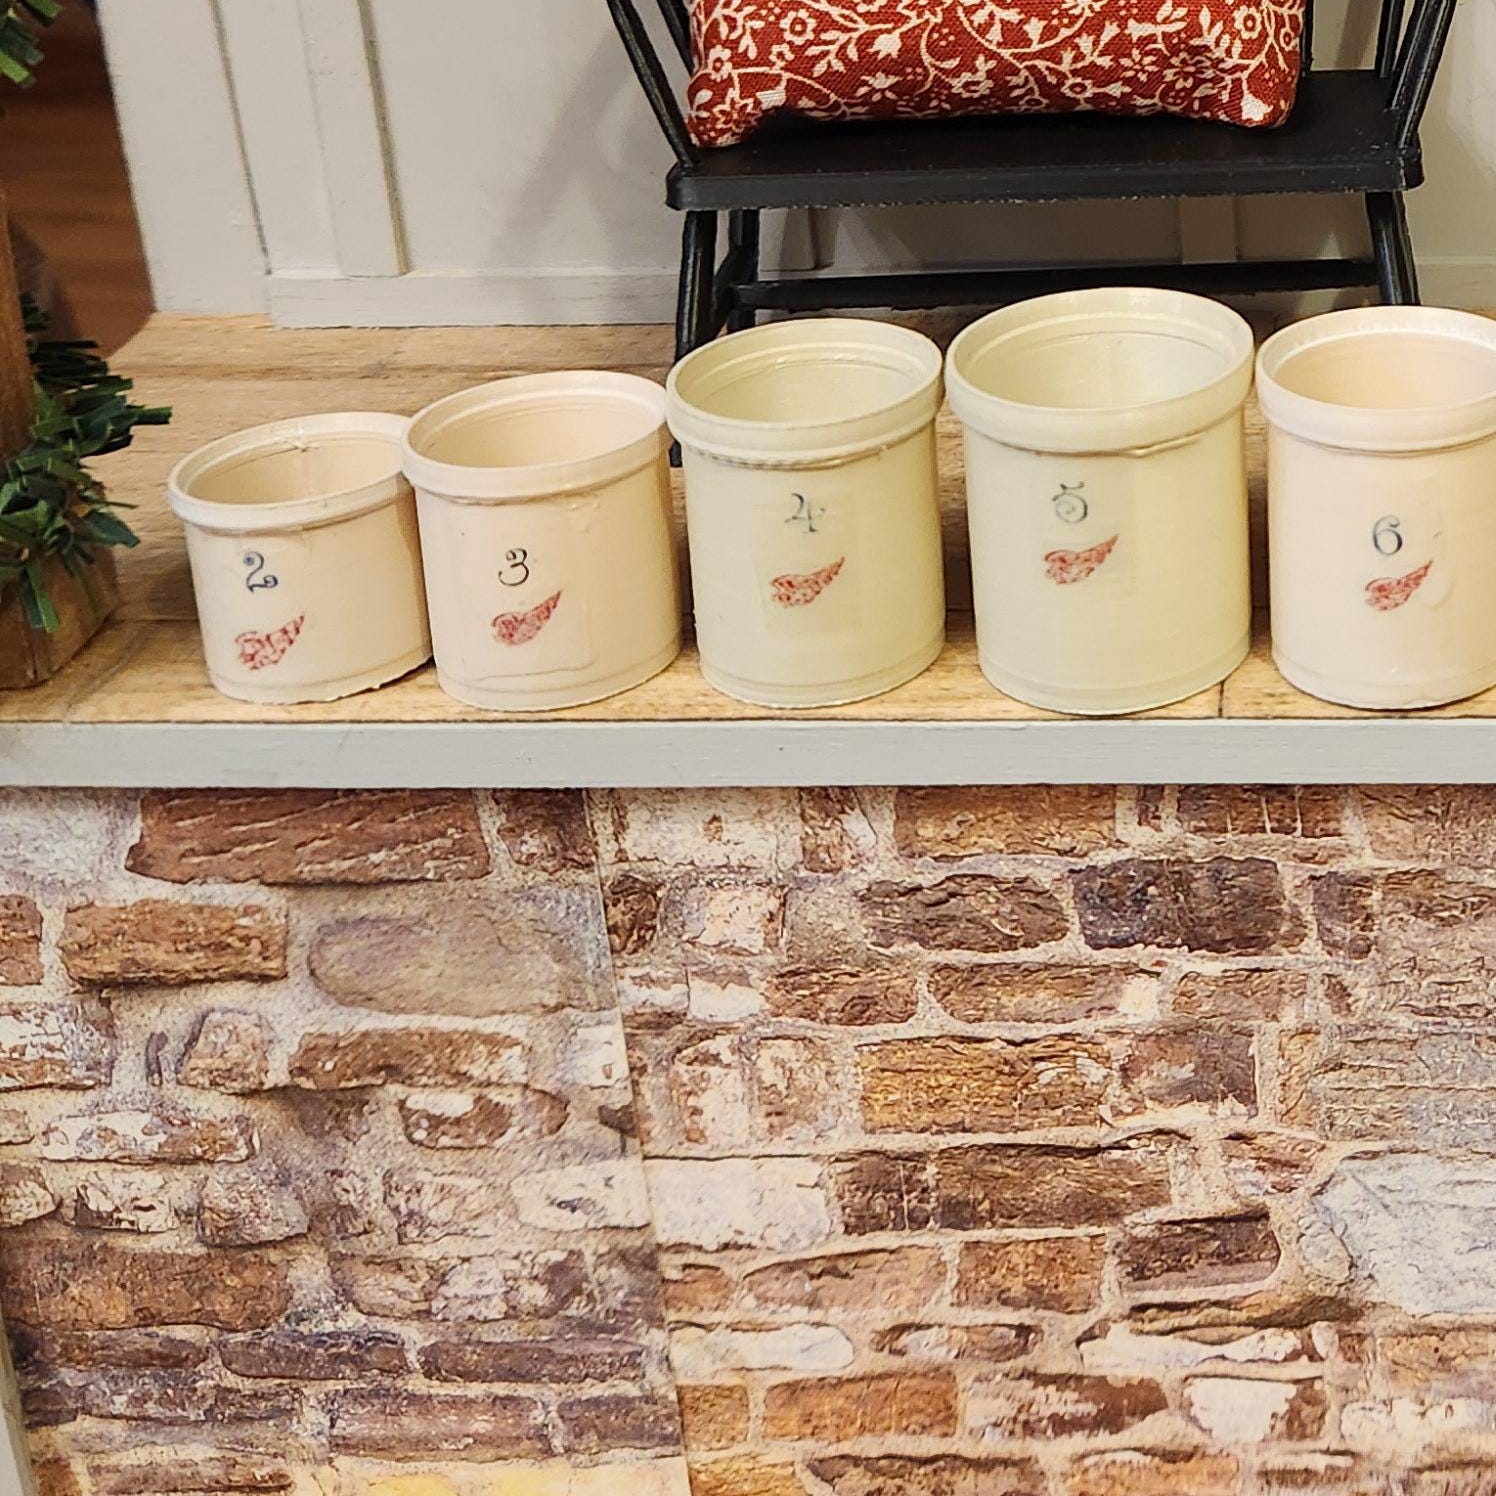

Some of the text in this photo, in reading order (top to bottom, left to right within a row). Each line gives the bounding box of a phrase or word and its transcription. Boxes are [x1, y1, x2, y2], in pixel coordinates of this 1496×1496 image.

[1372, 514, 1403, 556] 6
[242, 550, 279, 593] 2
[498, 547, 530, 587] 3
